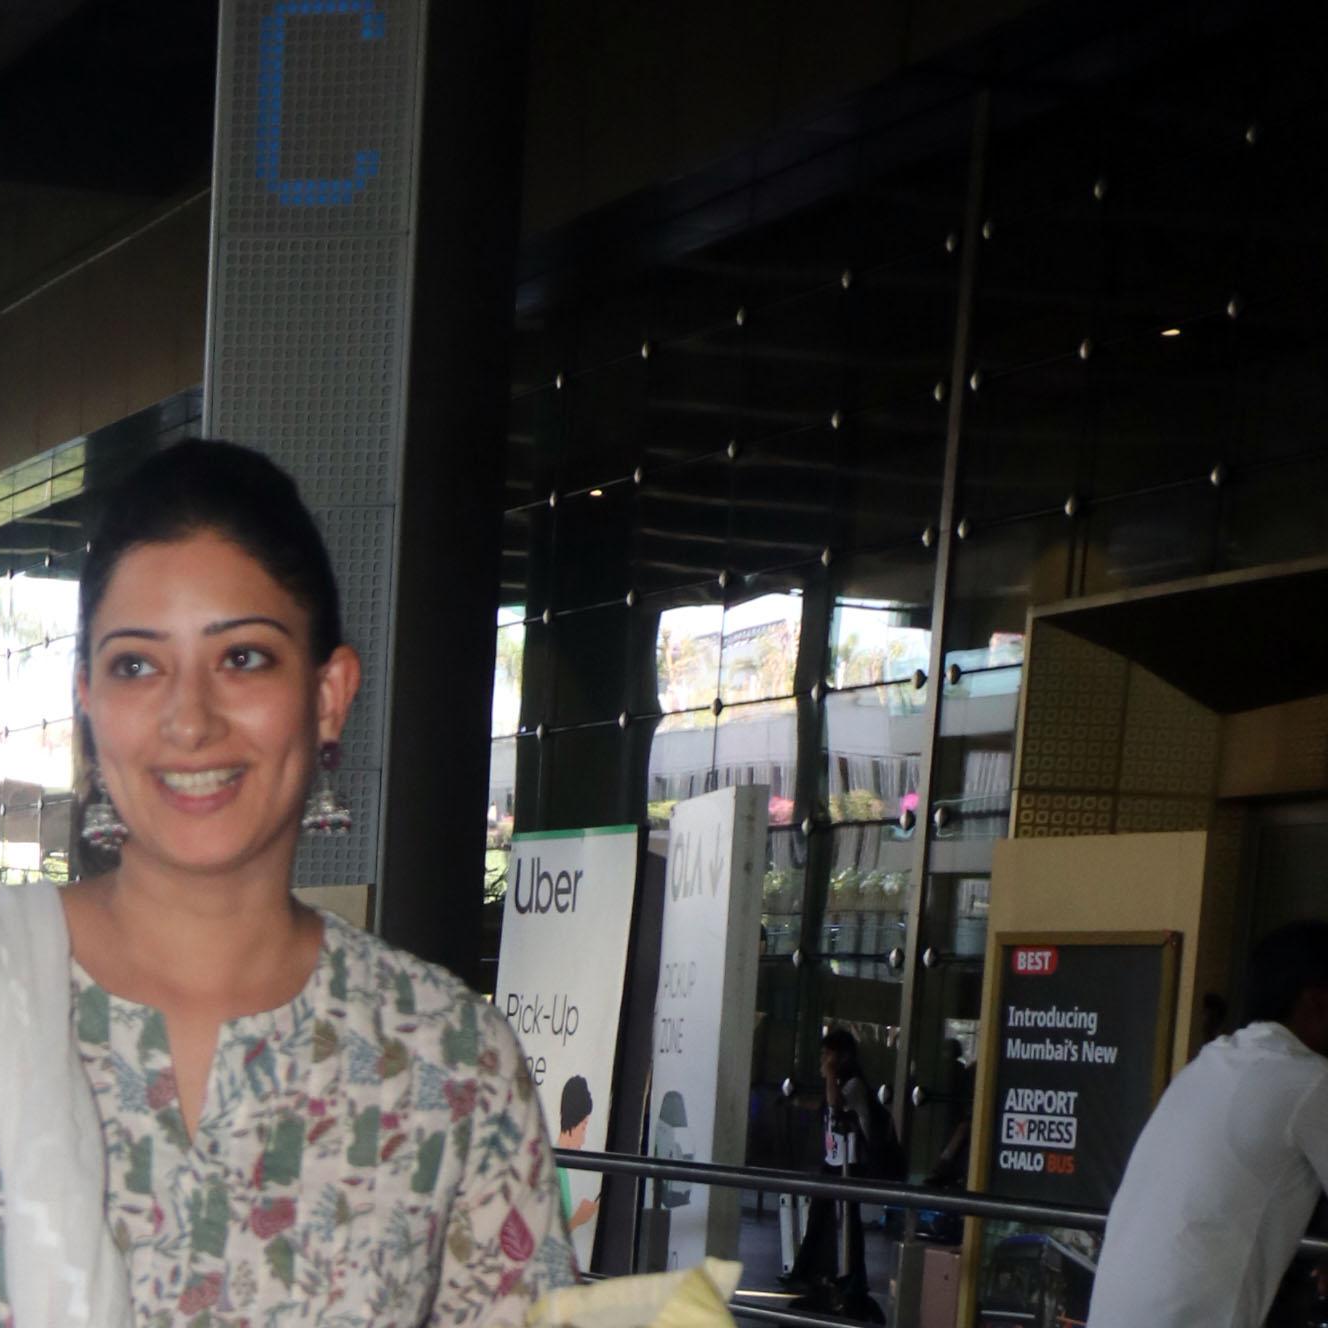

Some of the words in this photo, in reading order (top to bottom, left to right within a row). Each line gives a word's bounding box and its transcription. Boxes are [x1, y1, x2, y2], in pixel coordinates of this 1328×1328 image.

[256, 0, 385, 206] C
[671, 832, 703, 901] OLA
[514, 857, 583, 915] Uber
[1017, 951, 1052, 971] BEST
[506, 993, 580, 1047] Pick-Up
[1008, 1005, 1098, 1035] Introducing
[1006, 1038, 1079, 1061] Mumbai's
[1082, 1041, 1118, 1064] New
[1004, 1088, 1078, 1115] AIRPORT
[1000, 1150, 1044, 1172] CHALO
[1047, 1153, 1074, 1174] BUS
